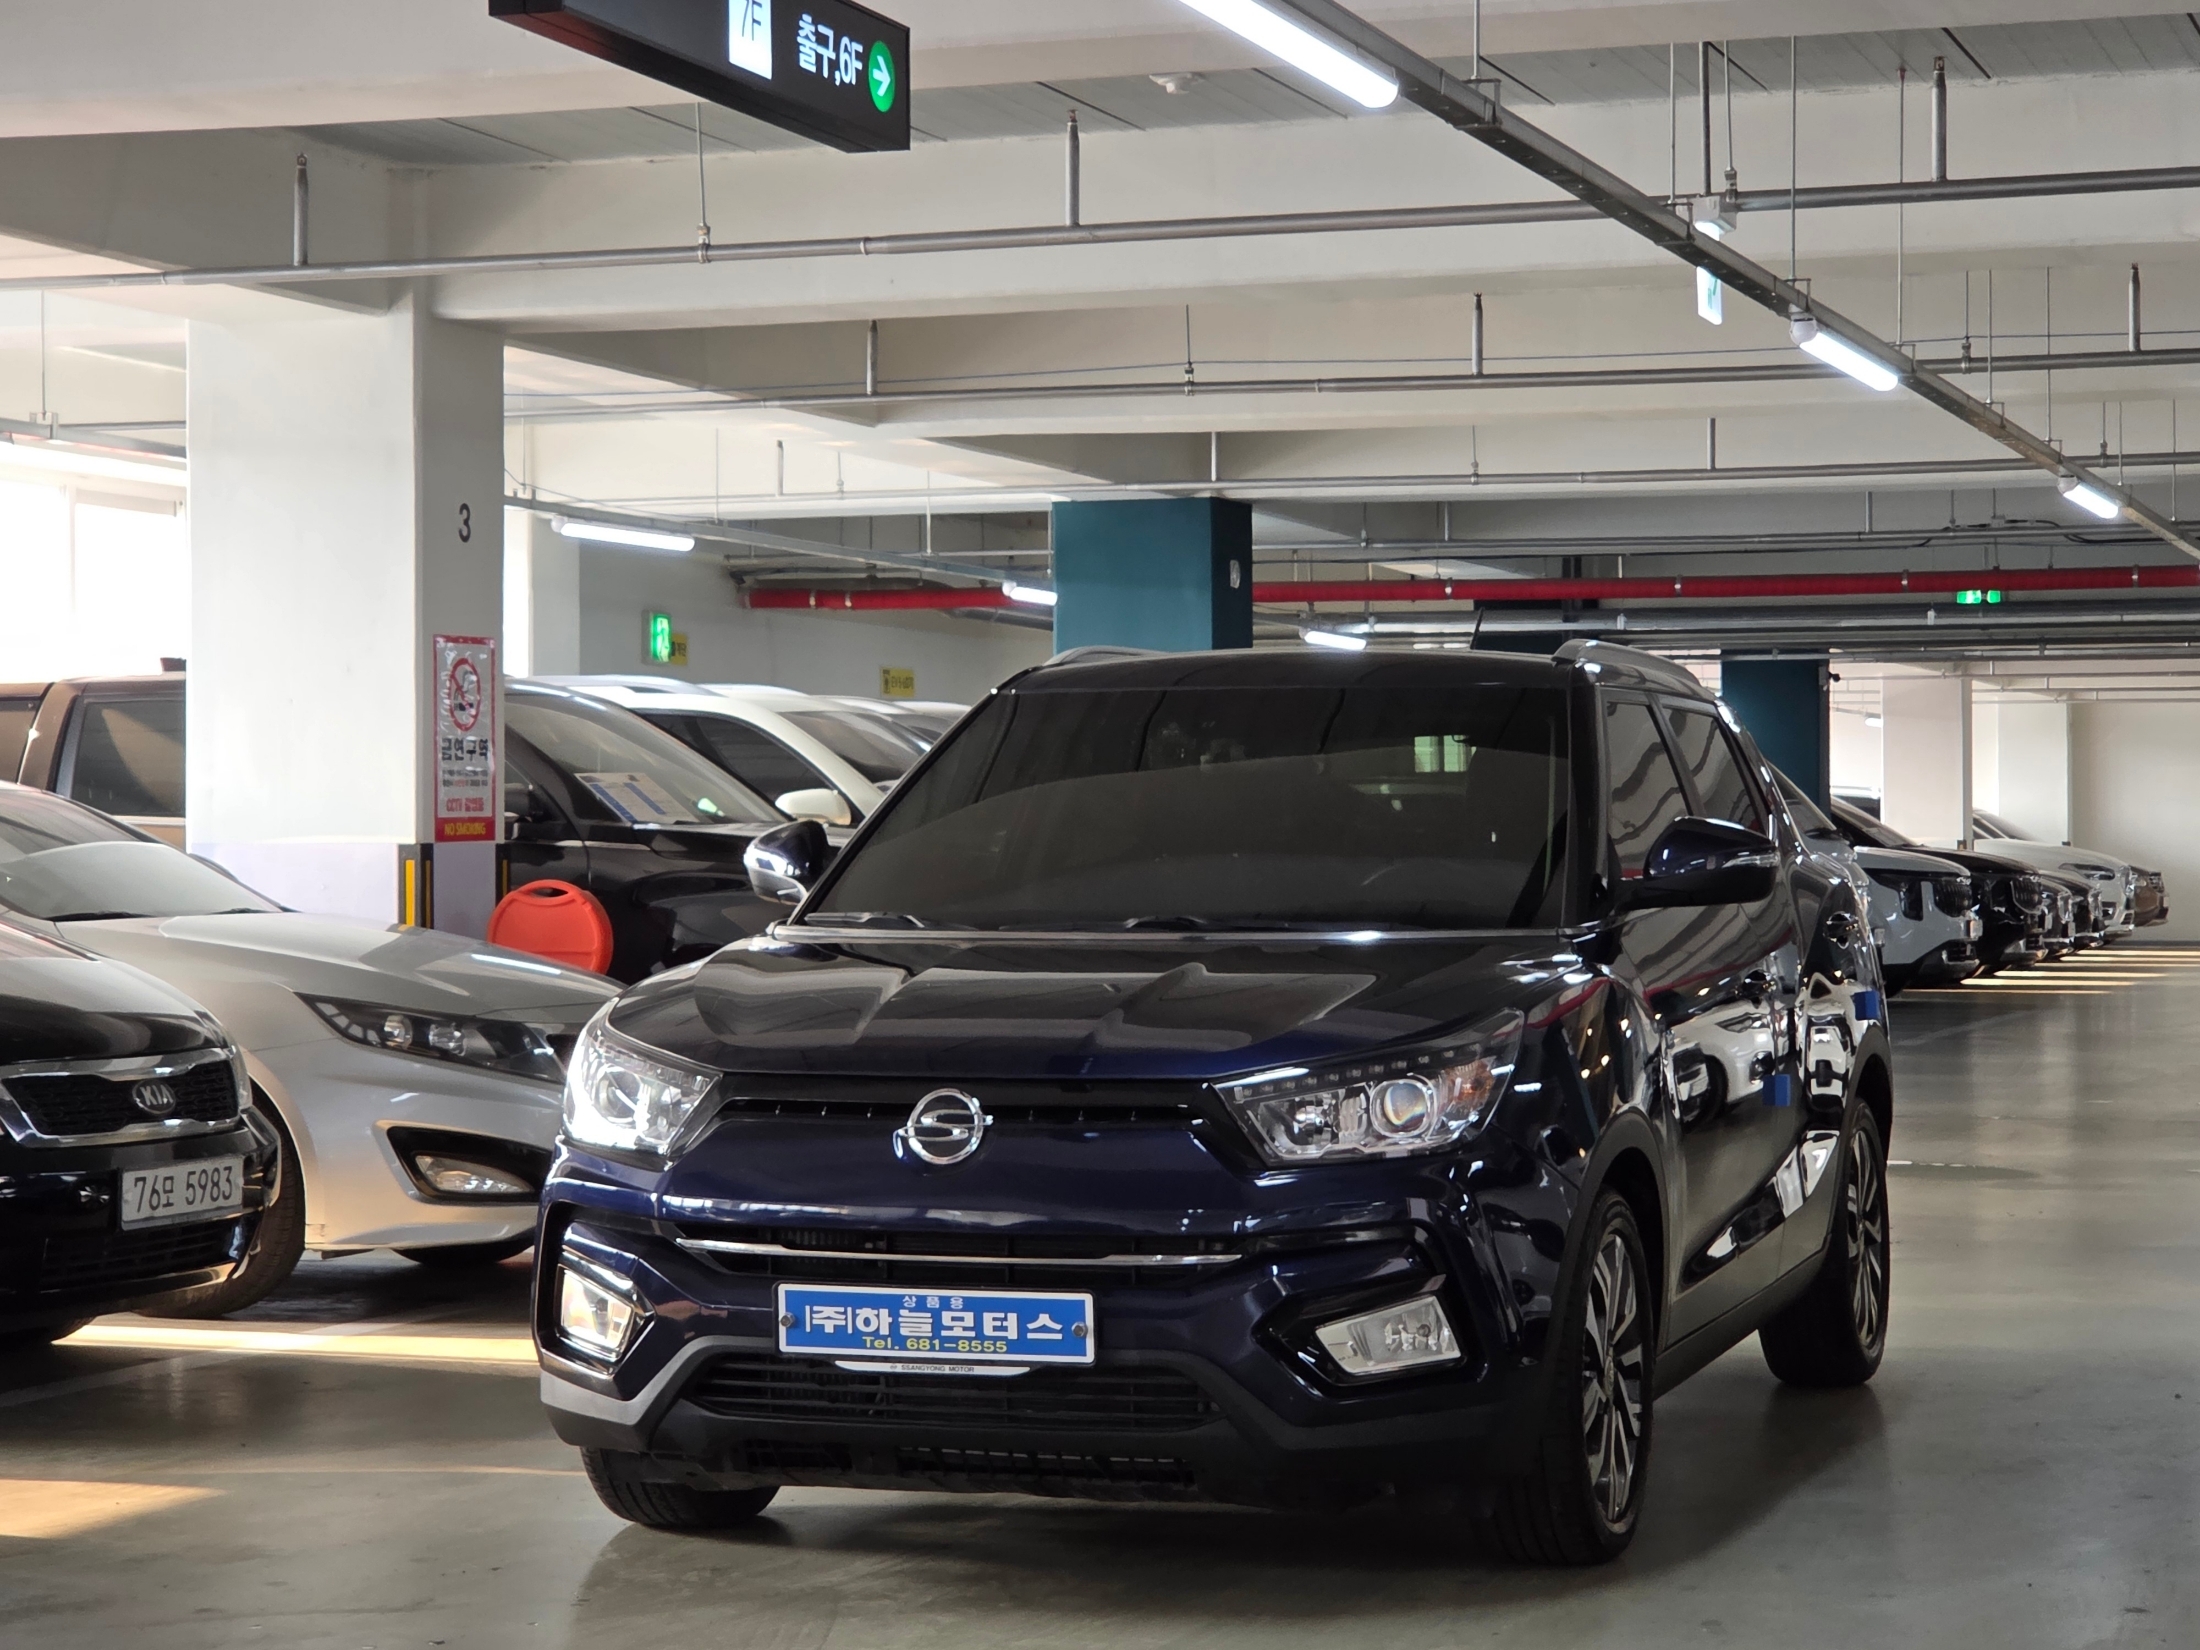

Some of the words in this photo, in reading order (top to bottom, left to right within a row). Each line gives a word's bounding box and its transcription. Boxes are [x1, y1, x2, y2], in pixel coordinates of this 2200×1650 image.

[741, 0, 763, 42] 7F
[458, 502, 472, 543] 3
[444, 823, 455, 836] NO
[456, 823, 486, 836] SMOKING
[140, 1084, 174, 1106] KIA
[134, 1175, 175, 1213] 76모
[185, 1166, 233, 1206] 5983
[862, 1336, 900, 1350] Tel.
[906, 1338, 1008, 1353] 681-8555
[901, 1364, 947, 1373] SSANGYONG
[948, 1366, 975, 1374] MOTOR
